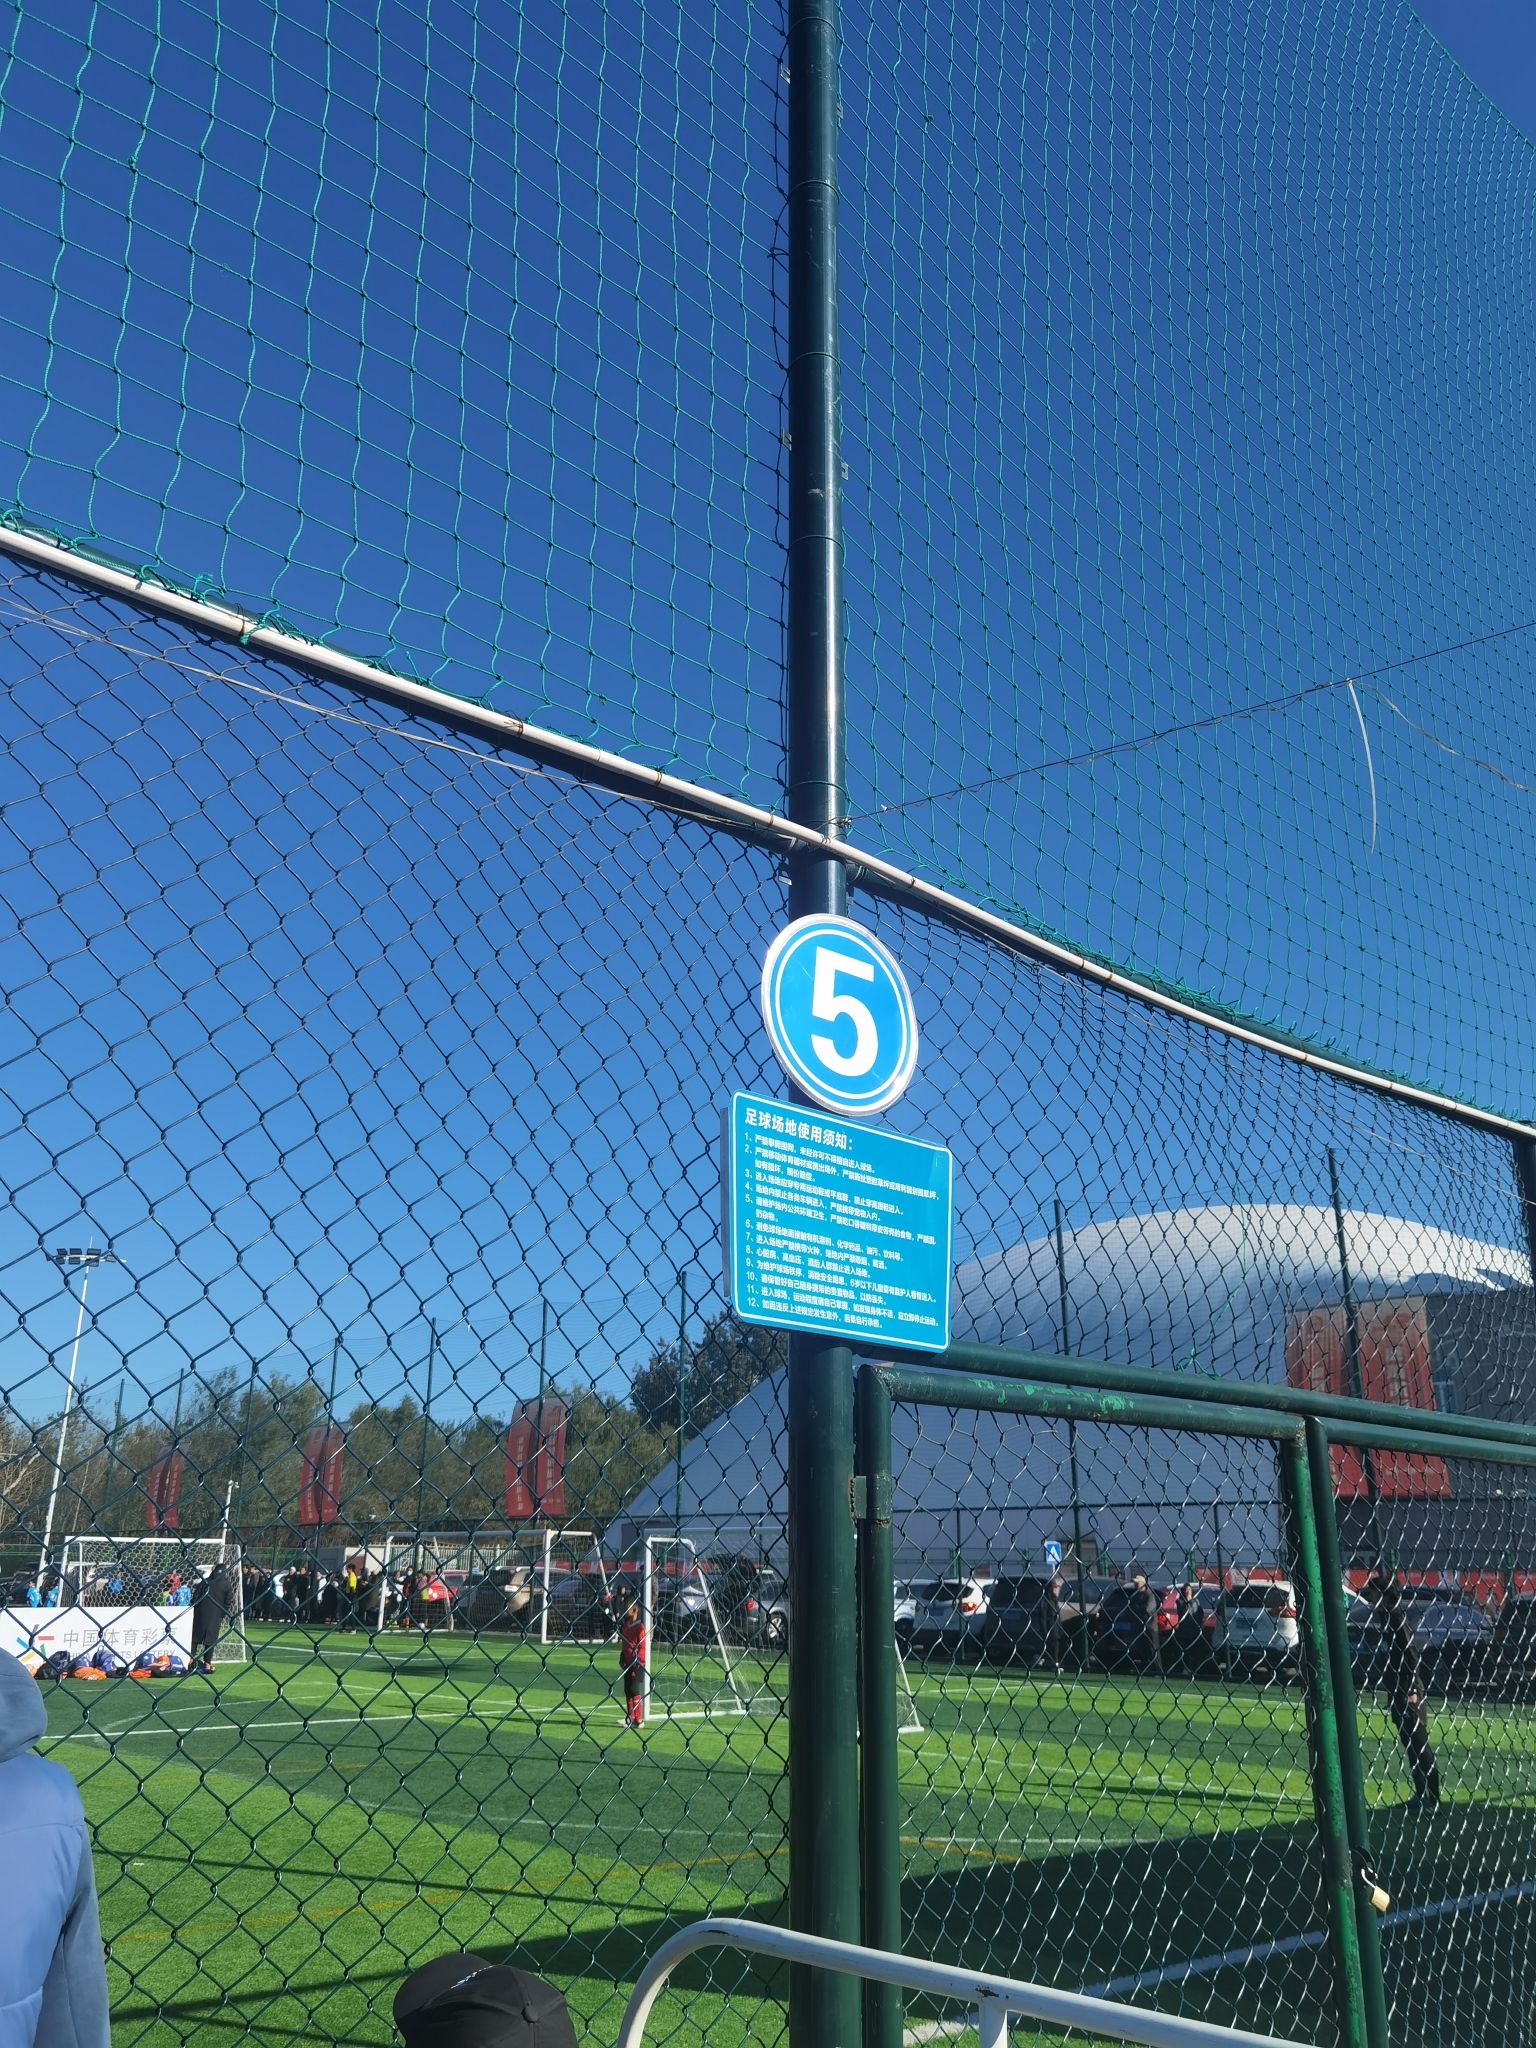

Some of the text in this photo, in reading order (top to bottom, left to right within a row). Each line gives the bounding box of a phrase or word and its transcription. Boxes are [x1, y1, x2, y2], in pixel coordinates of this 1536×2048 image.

[811, 945, 879, 1077] 5
[744, 1107, 854, 1150] 足球场地使用须知：
